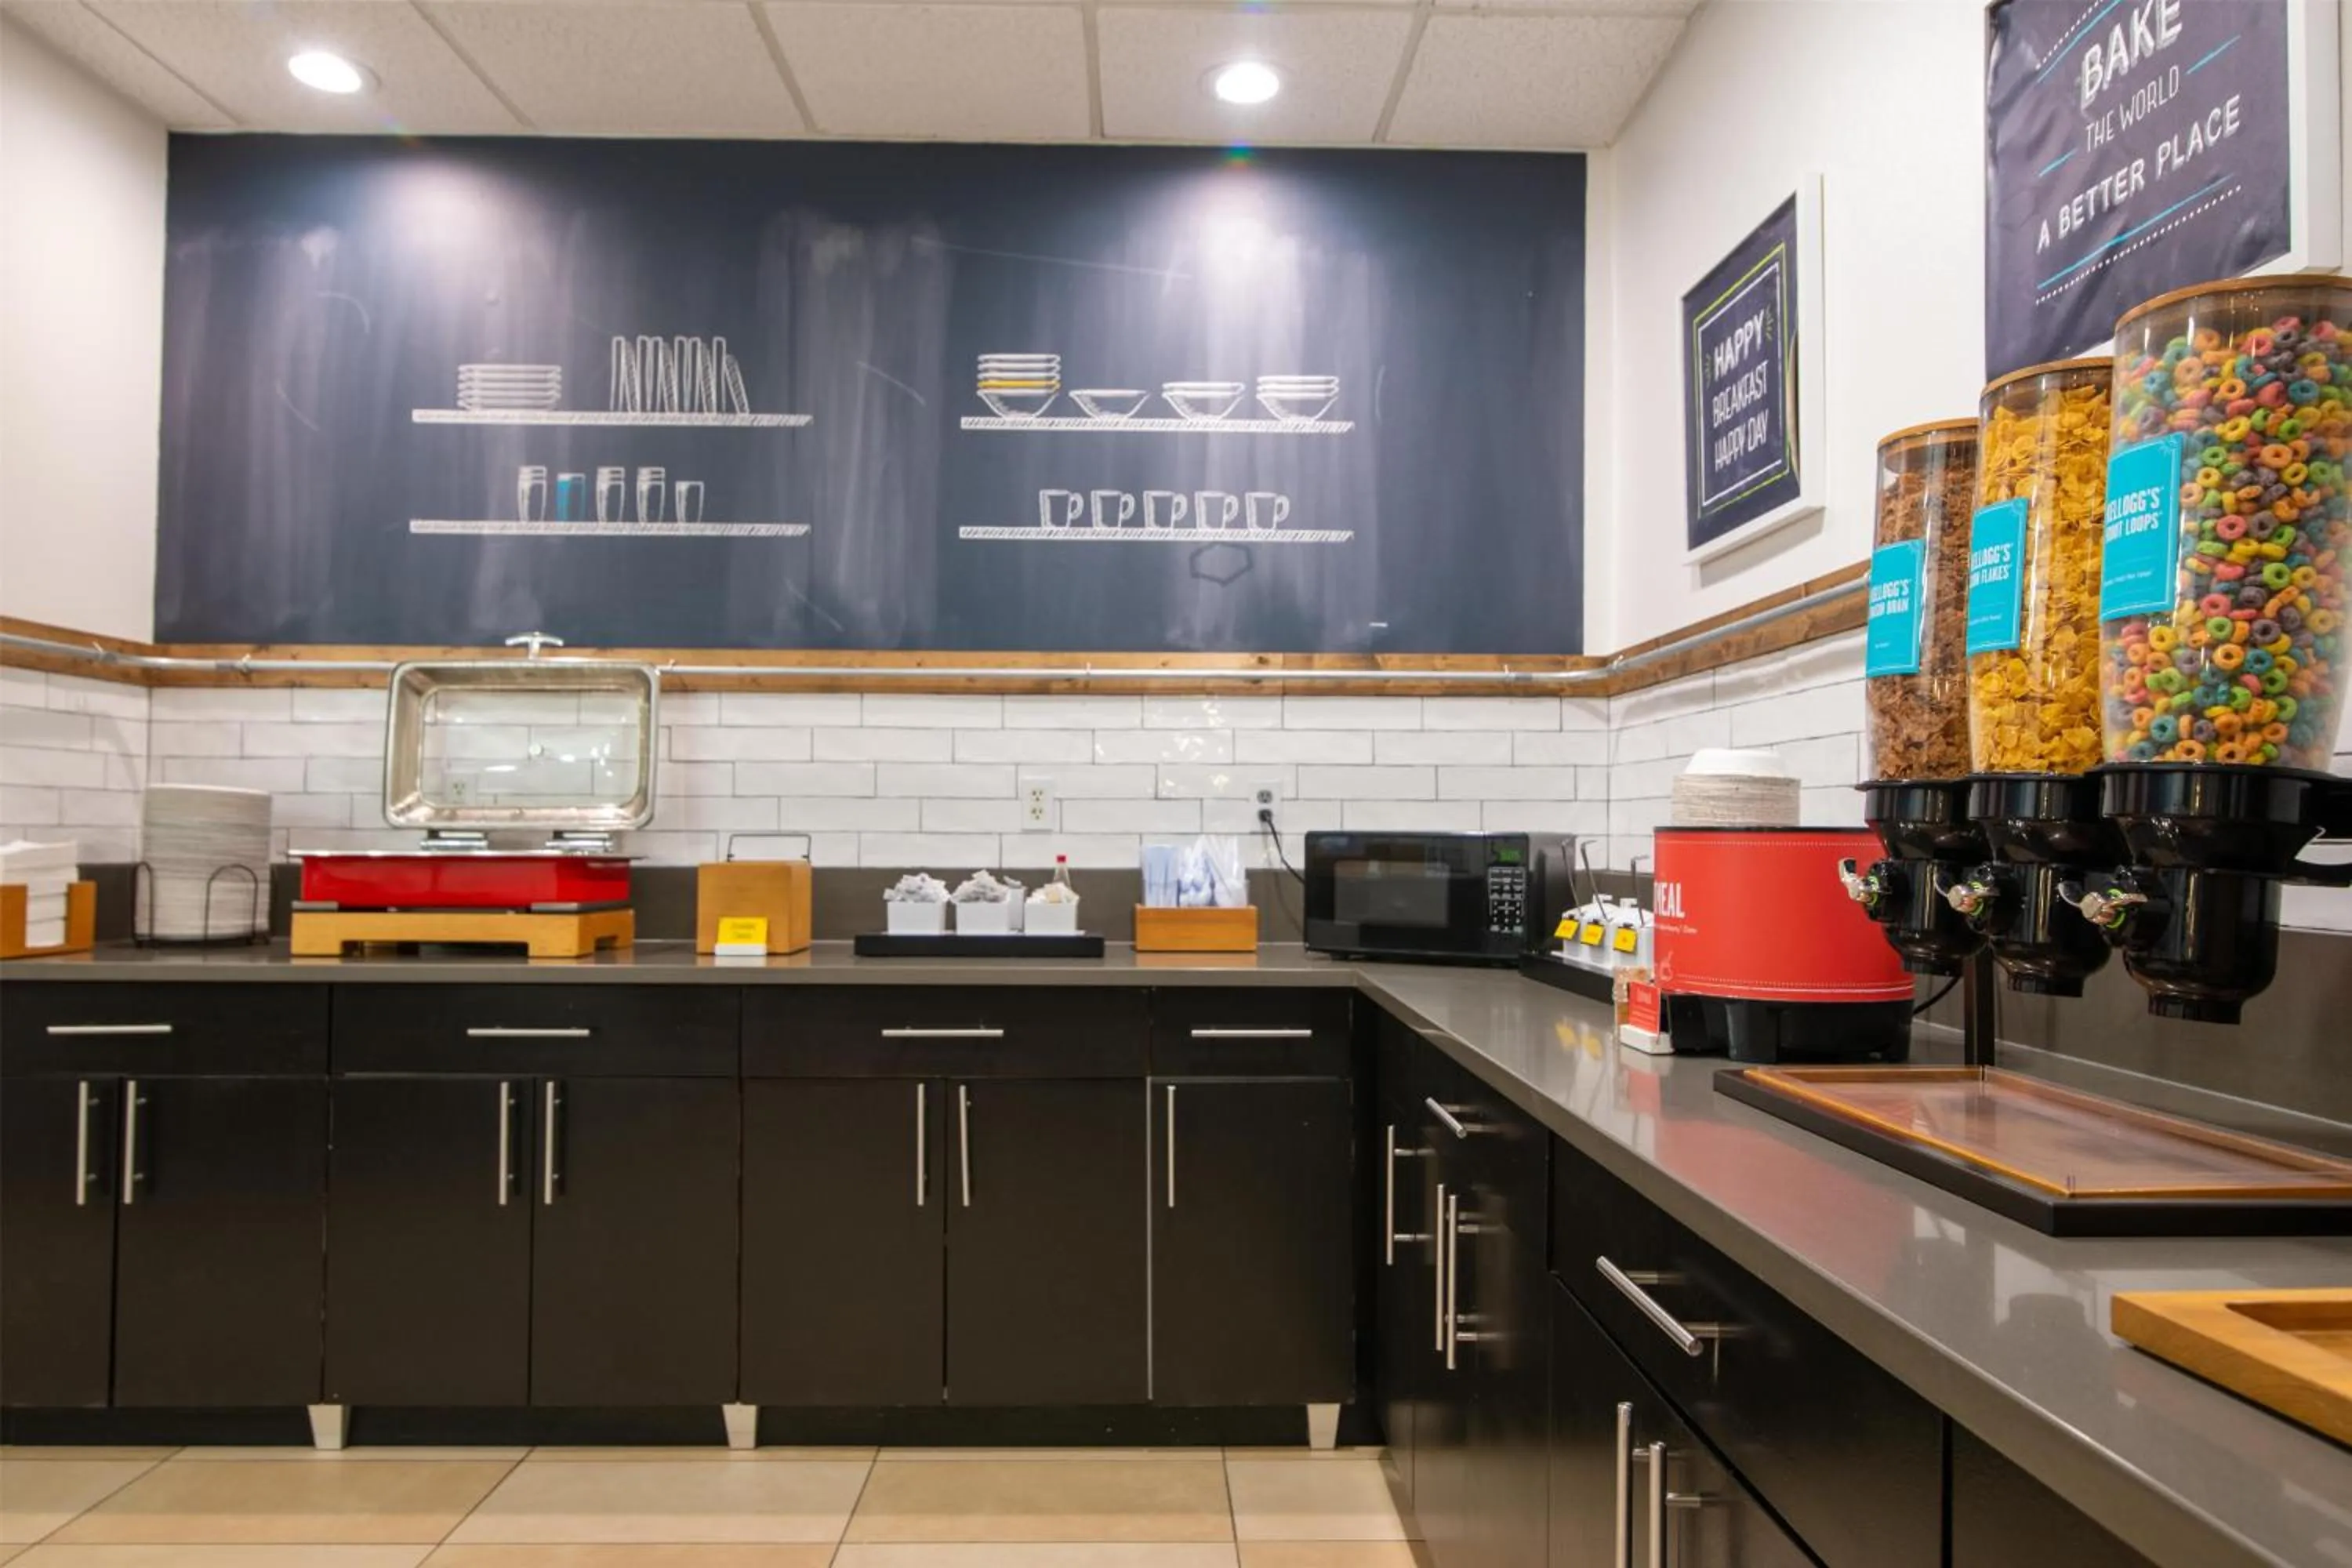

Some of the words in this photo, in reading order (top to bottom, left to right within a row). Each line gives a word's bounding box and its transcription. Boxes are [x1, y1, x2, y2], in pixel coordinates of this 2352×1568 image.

[2081, 0, 2183, 109] BAKE
[2085, 111, 2114, 152] THE
[2119, 64, 2179, 132] WORLD
[2036, 219, 2050, 255] A
[2058, 158, 2145, 239] BETTER
[2156, 94, 2240, 180] PLACE
[1714, 309, 1765, 381] HAPPY
[1712, 360, 1769, 429] BREAKFAST
[1715, 423, 1746, 472] HAPPY
[1748, 408, 1769, 452] DAY
[2125, 512, 2159, 536] LOOPS
[1980, 564, 2010, 584] FLAKES
